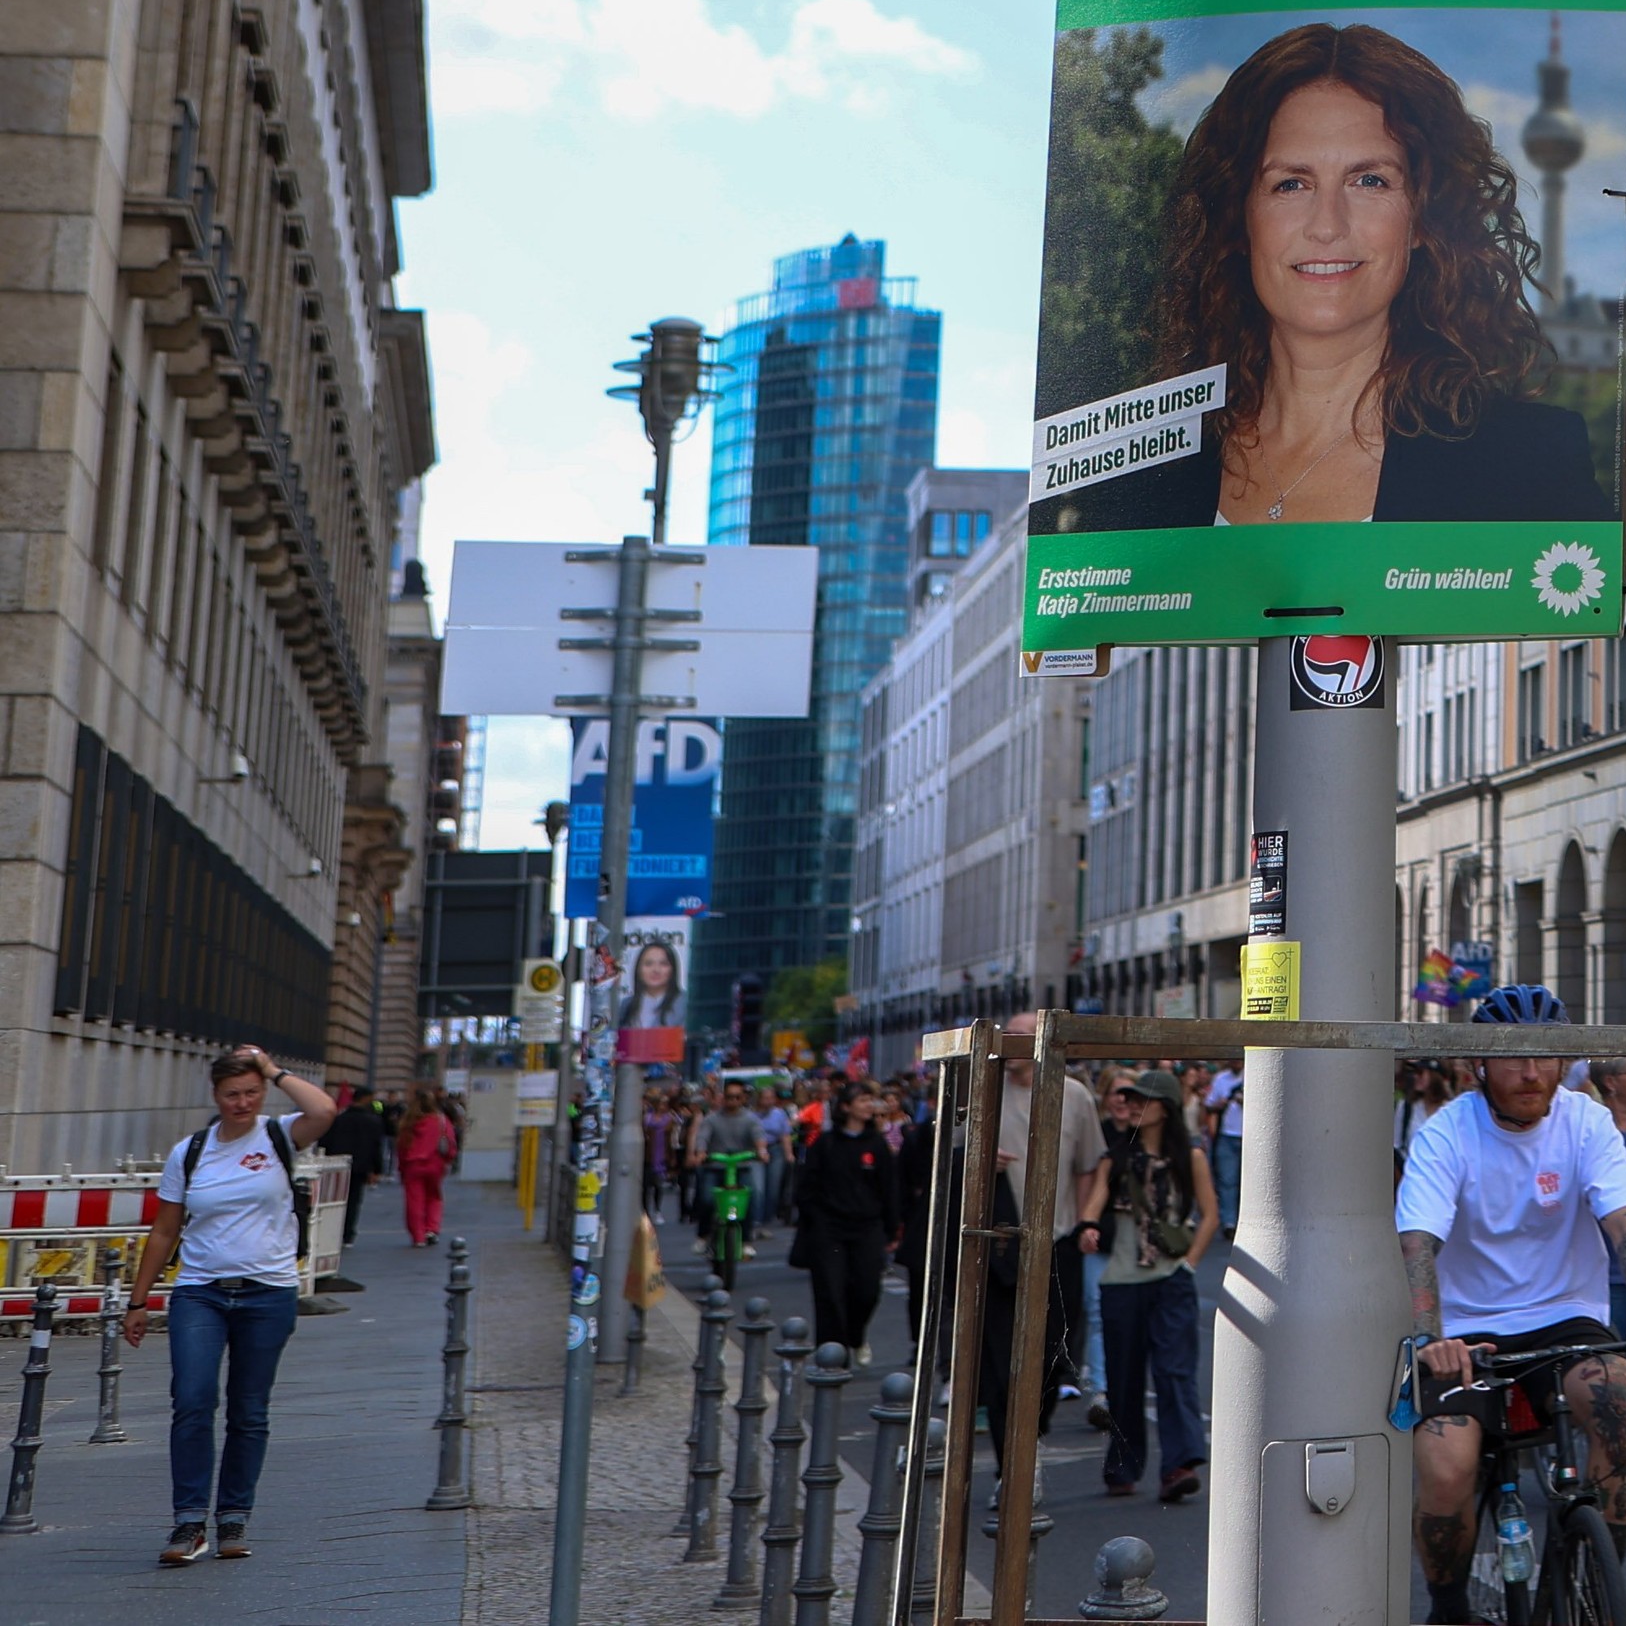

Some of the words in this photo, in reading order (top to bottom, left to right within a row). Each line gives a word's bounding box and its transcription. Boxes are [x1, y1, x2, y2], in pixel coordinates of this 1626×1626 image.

[1046, 412, 1100, 450] Damit
[1105, 397, 1154, 432] Mitte
[1159, 380, 1216, 415] unser
[1046, 446, 1124, 490] Zuhause
[1129, 426, 1191, 464] bleibt.
[1038, 566, 1132, 589] Erststimme
[1385, 568, 1431, 589] Grün
[1435, 568, 1513, 589] wählen!
[1037, 593, 1078, 618] Katja
[1080, 592, 1193, 614] Zimmermann
[1044, 654, 1093, 662] VORDERMANN
[1319, 690, 1364, 703] AKTION
[572, 719, 722, 787] AfD
[1258, 835, 1284, 849] HIER
[1258, 848, 1284, 856] WURDE
[677, 896, 704, 909] AfD
[1265, 975, 1288, 984] EINEN
